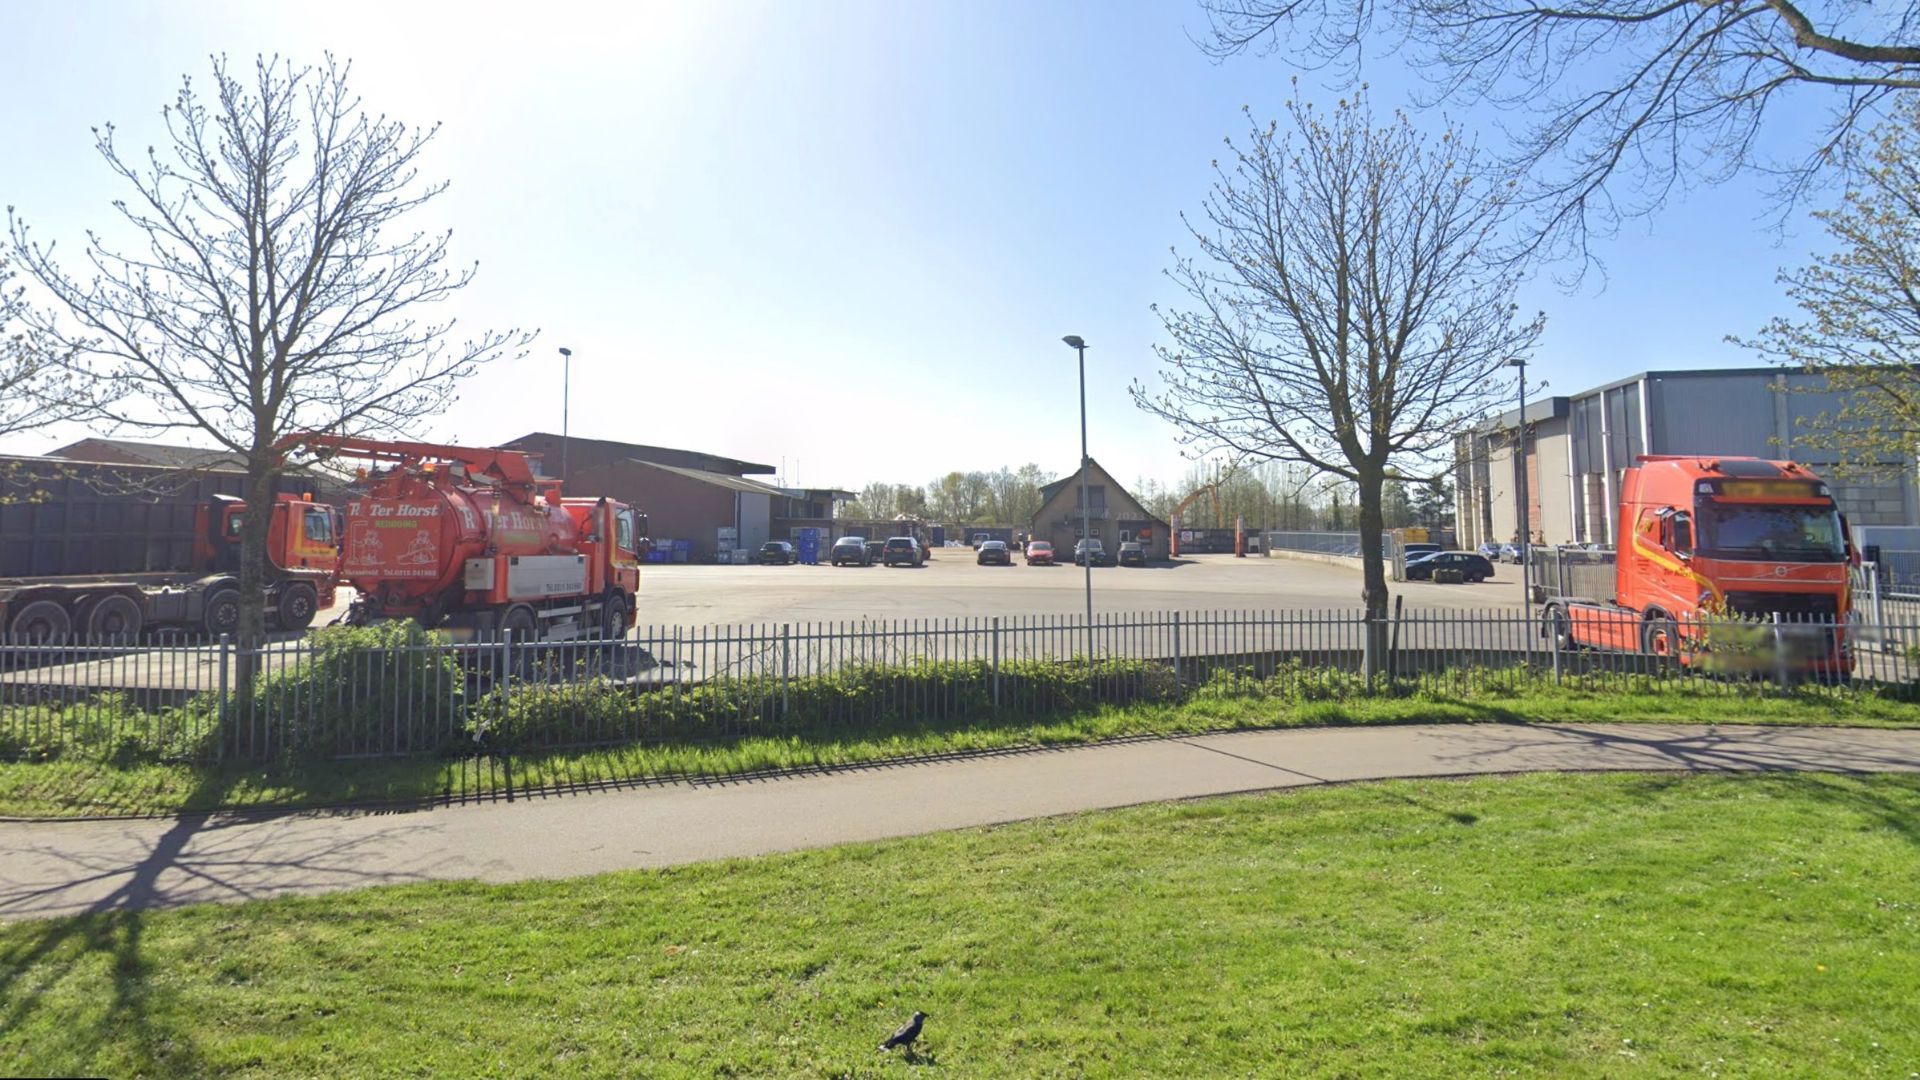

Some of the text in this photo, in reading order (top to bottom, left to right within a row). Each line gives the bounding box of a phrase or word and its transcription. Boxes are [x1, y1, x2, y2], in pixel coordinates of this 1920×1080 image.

[369, 504, 394, 516] Ter
[396, 504, 439, 516] Horst
[483, 509, 509, 529] Ter
